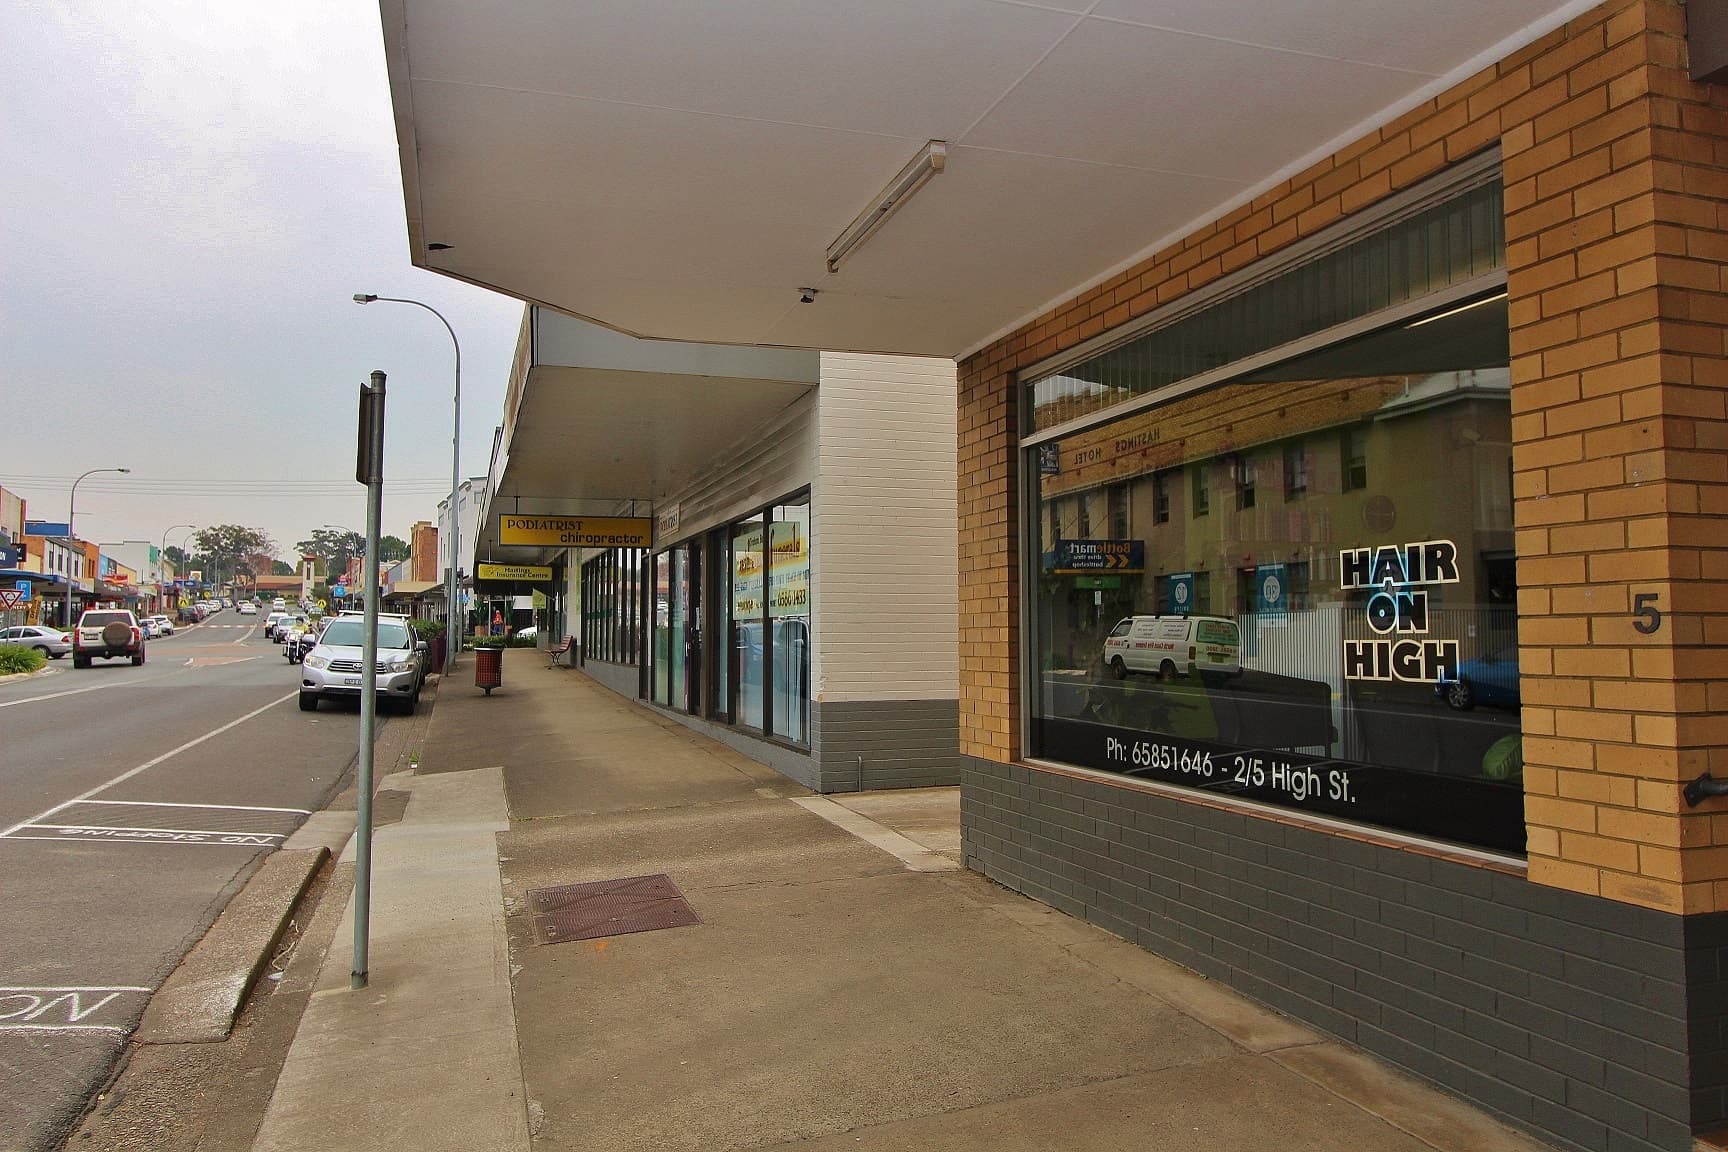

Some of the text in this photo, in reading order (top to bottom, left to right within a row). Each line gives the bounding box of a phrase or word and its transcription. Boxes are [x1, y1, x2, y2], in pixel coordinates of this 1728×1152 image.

[507, 519, 583, 531] PODIATRIST
[560, 531, 644, 545] chiropractor
[1340, 540, 1460, 590] HAIR
[1366, 591, 1429, 634] ON
[1632, 592, 1662, 634] 5
[1343, 639, 1461, 683] HIGH
[1106, 737, 1127, 762] Ph:
[1132, 741, 1213, 777] 65851646
[1234, 756, 1265, 787] 2/5
[1272, 761, 1321, 801] High
[1328, 770, 1356, 803] St.
[220, 836, 274, 844] NO
